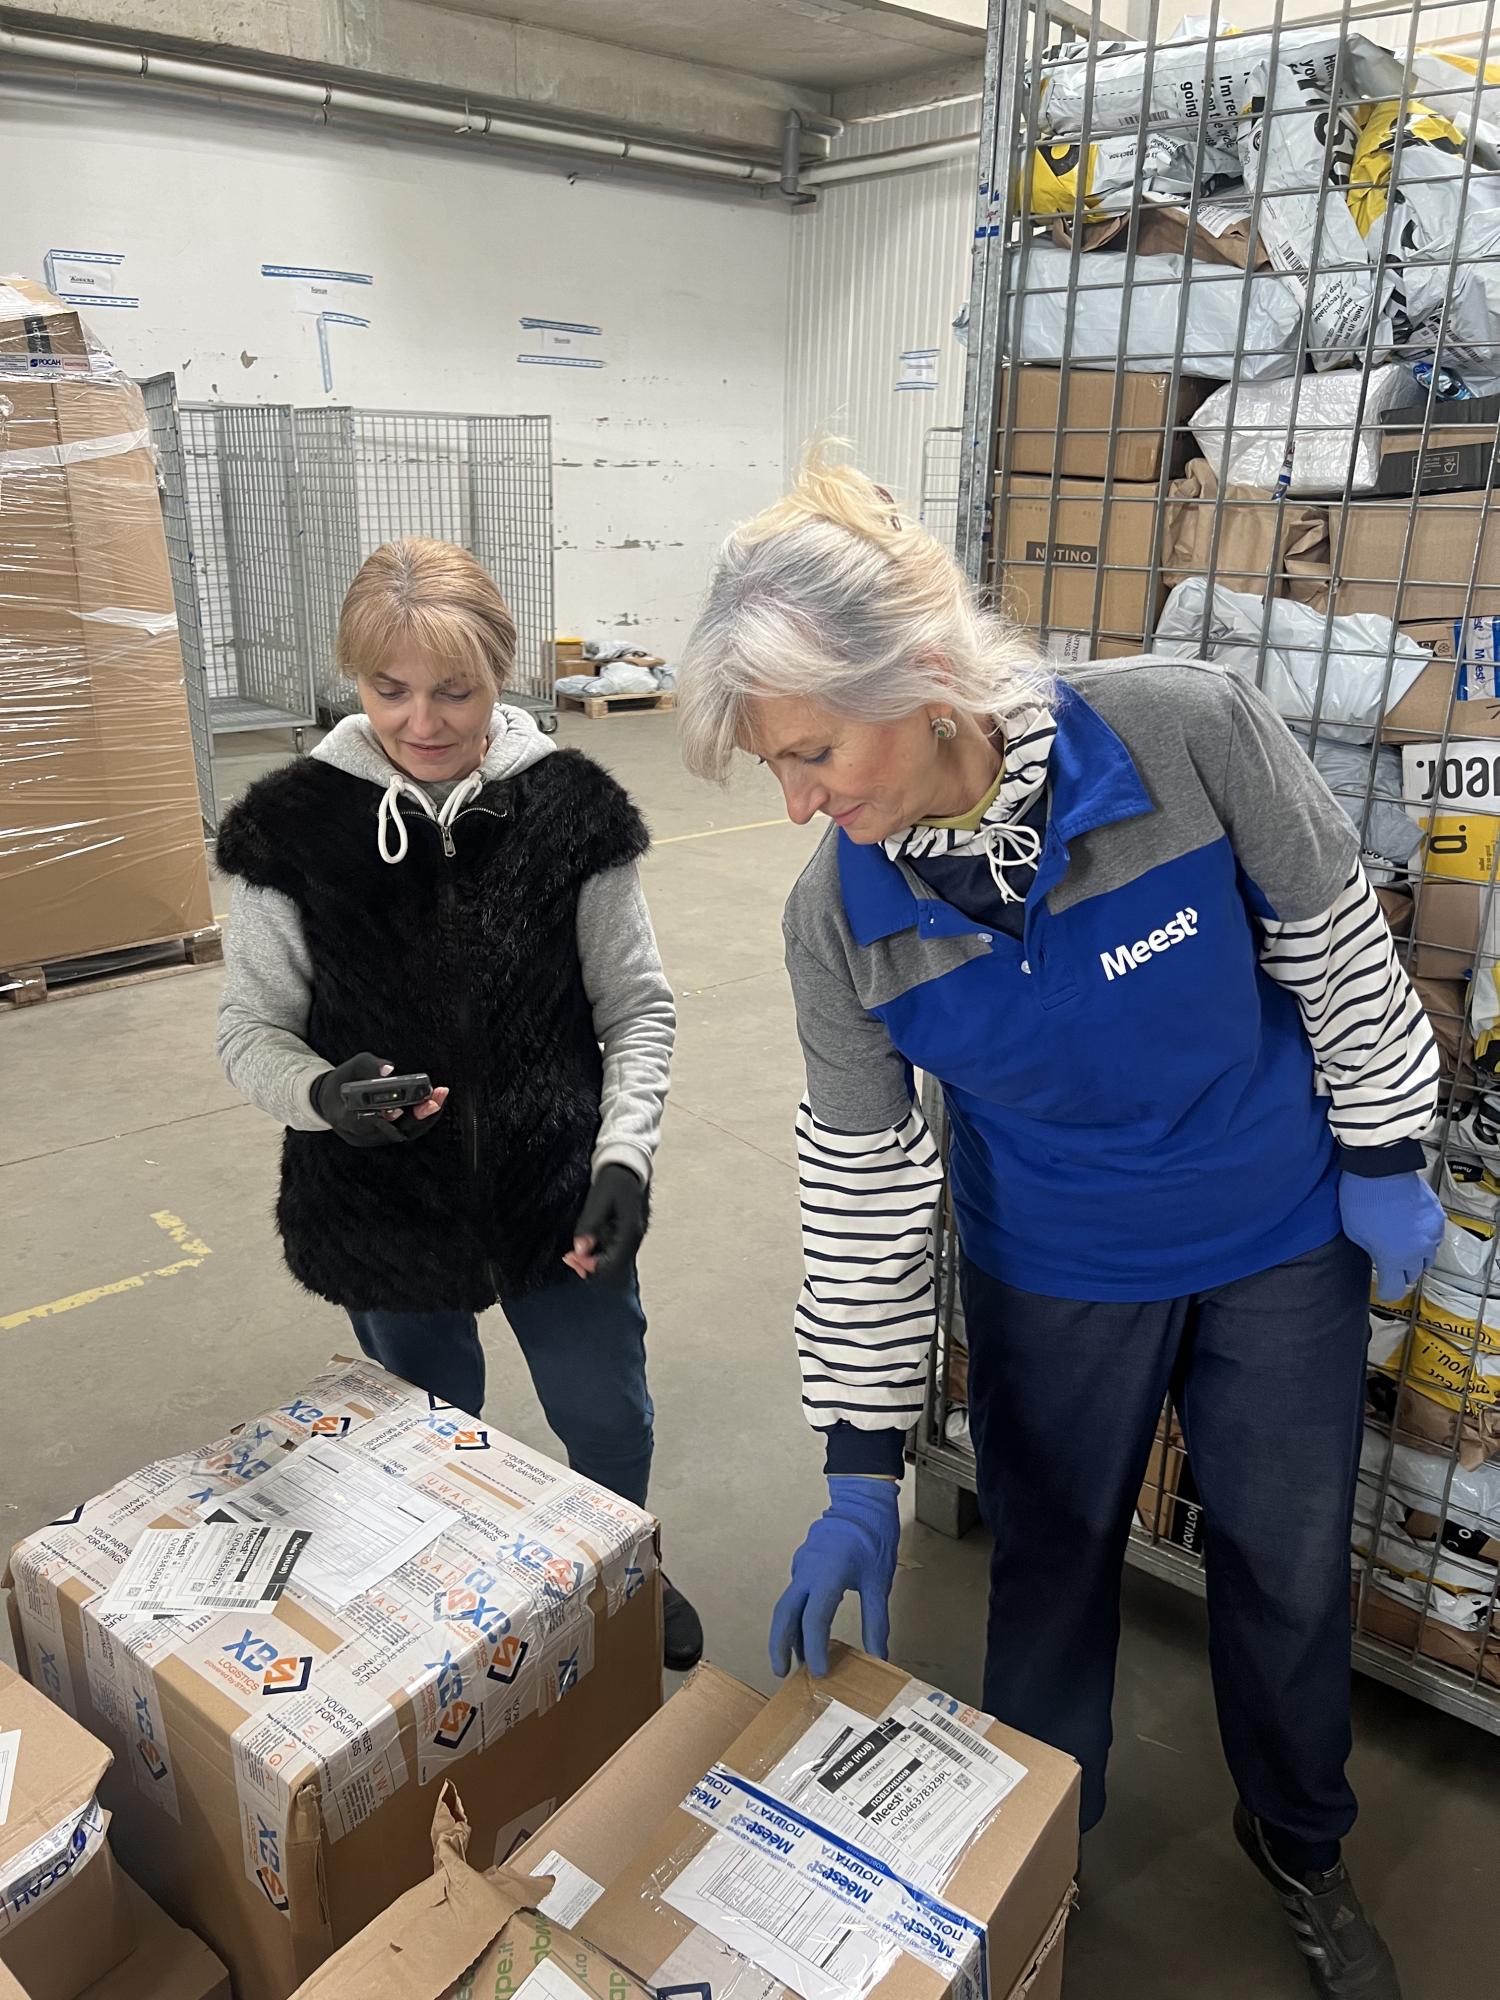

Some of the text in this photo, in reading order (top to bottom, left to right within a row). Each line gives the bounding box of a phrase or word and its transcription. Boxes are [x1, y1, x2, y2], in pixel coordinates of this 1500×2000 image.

[1180, 81, 1199, 118] going
[1035, 547, 1092, 563] NTINO
[1474, 648, 1487, 685] Mest
[1100, 907, 1198, 981] Meest
[501, 1459, 547, 1486] FOR SAVINGS
[505, 1452, 526, 1467] YOUR
[524, 1460, 557, 1483] PARTNER
[92, 1526, 132, 1557] YOUR PARTNE
[175, 1531, 196, 1561] Meest
[239, 1527, 260, 1556] Meest
[468, 1519, 499, 1543] SAVINGS
[84, 1534, 126, 1565] FOR SAVINGS
[208, 1532, 244, 1589] CV046345042PL
[278, 1553, 293, 1575] (HUB)
[204, 1659, 228, 1679] powered
[218, 1657, 260, 1691] LOGISTICS
[351, 1645, 391, 1678] SAVINGS
[354, 1652, 399, 1687] PARTNER
[315, 1707, 335, 1727] FOR
[332, 1721, 362, 1758] SAVINGS
[323, 1695, 349, 1719] YOUR
[345, 1713, 373, 1755] PARTNER
[832, 1741, 876, 1781] Львів (HUB)
[870, 1769, 911, 1807] ПОВЕРНЕННЯ
[890, 1770, 952, 1827] CV046378329PL
[870, 1792, 905, 1825] Meest
